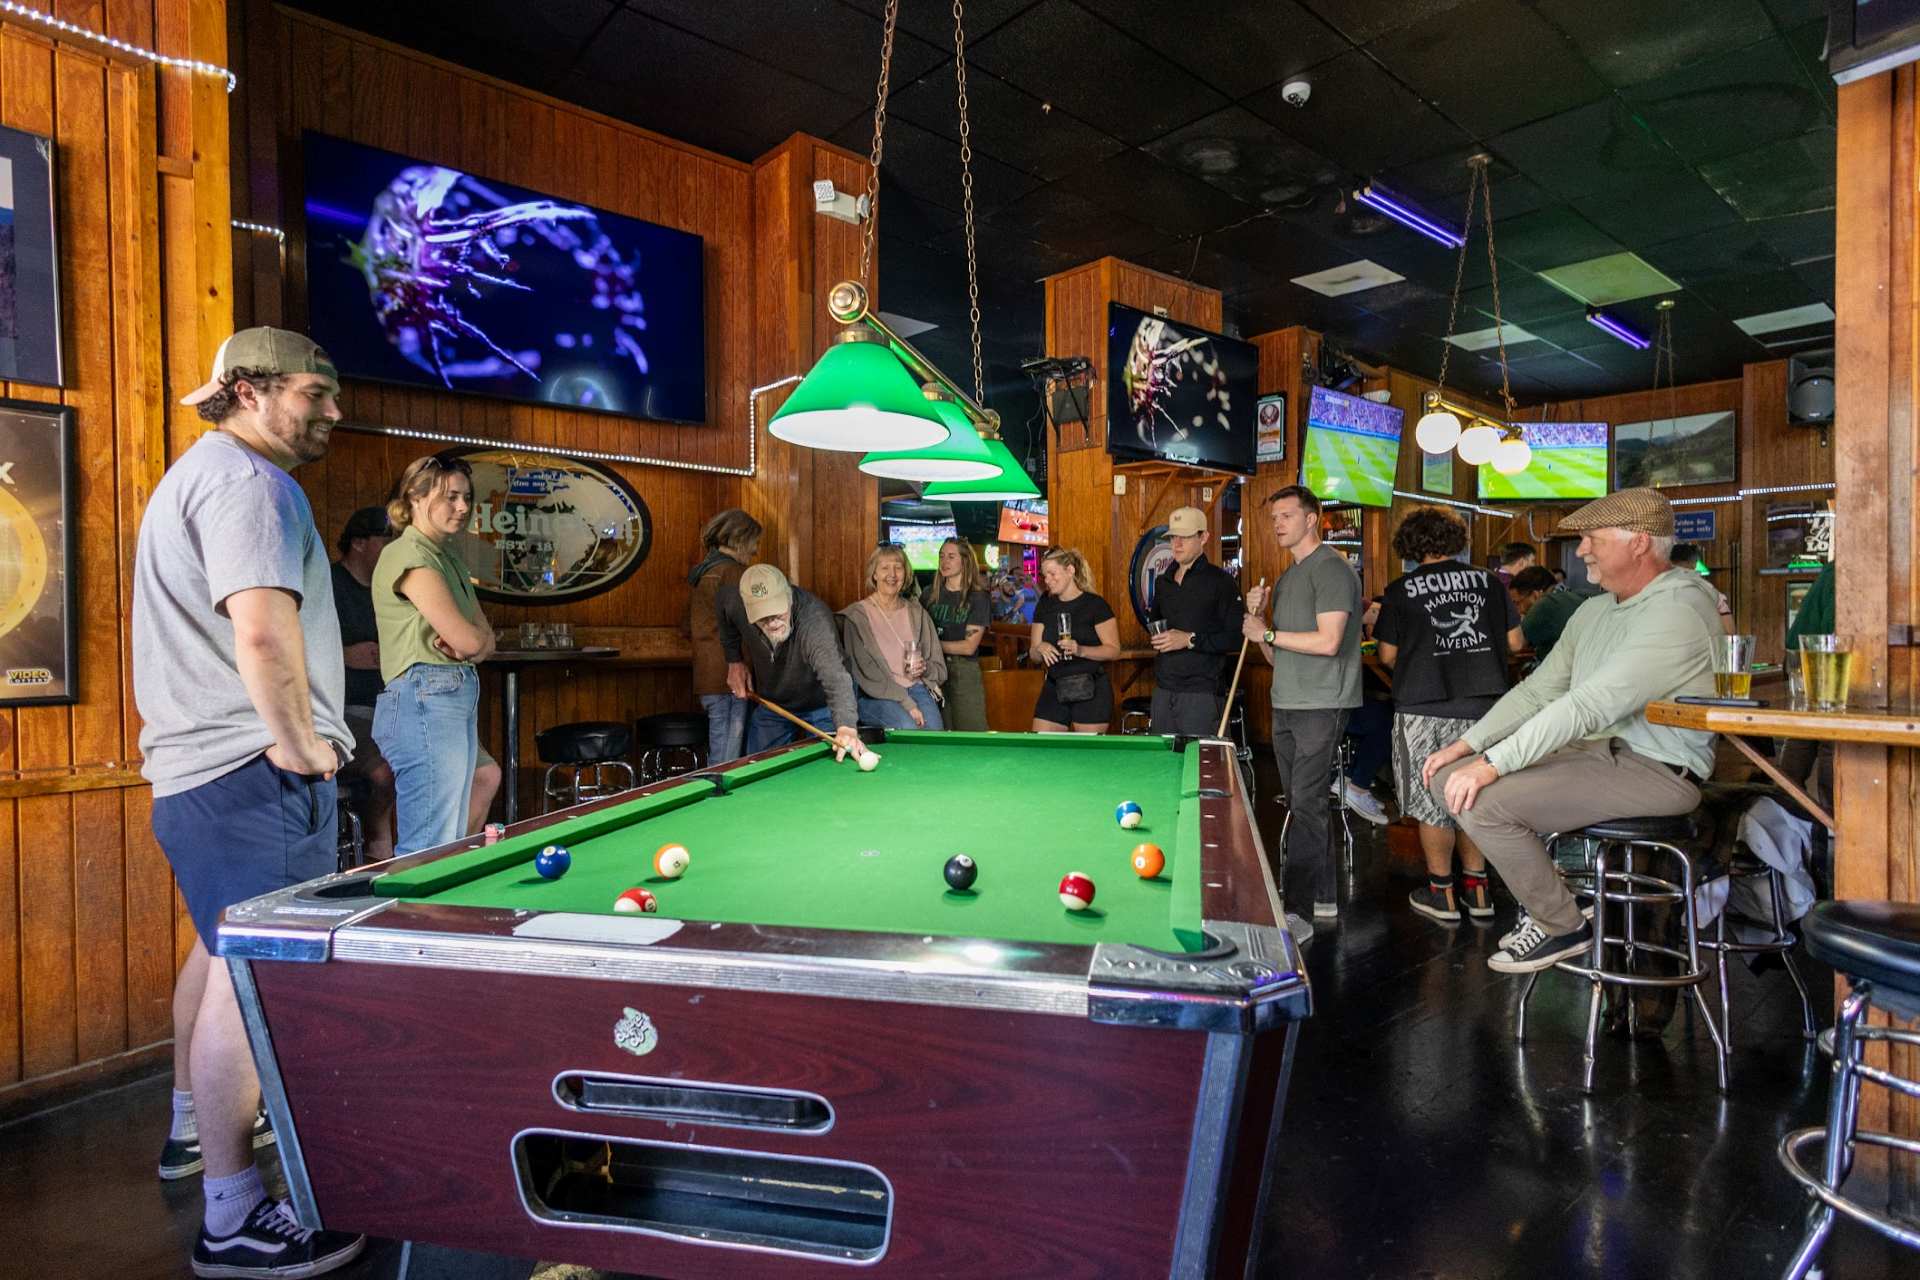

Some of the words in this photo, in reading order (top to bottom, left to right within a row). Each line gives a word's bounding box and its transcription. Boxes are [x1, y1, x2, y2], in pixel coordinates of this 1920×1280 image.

[1404, 570, 1489, 598] SECURITY
[1423, 591, 1486, 613] MARATHON
[1435, 631, 1488, 649] TAVERNA
[9, 670, 49, 679] VIDEO
